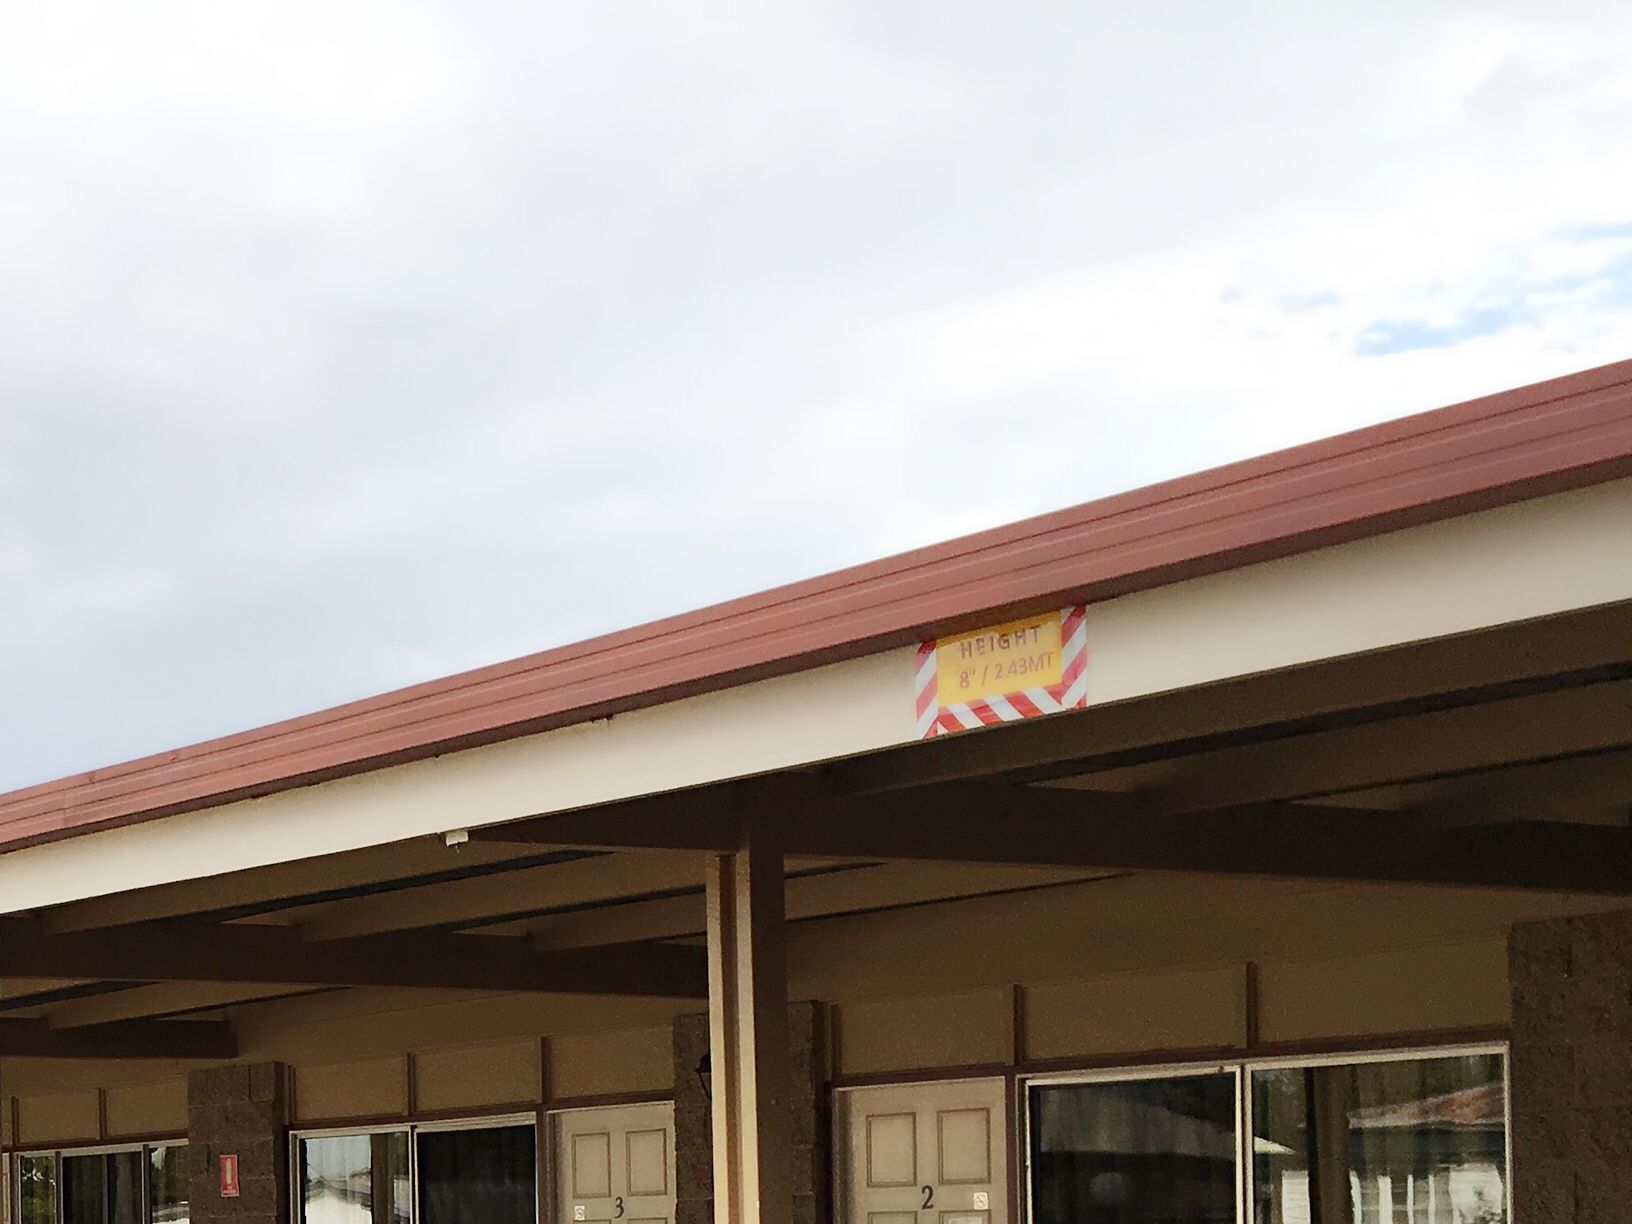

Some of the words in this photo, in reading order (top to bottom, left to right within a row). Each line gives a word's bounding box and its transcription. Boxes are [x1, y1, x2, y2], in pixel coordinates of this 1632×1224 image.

[960, 625, 1040, 659] HEIGHT
[614, 1196, 625, 1219] 3
[921, 1185, 934, 1210] 2
